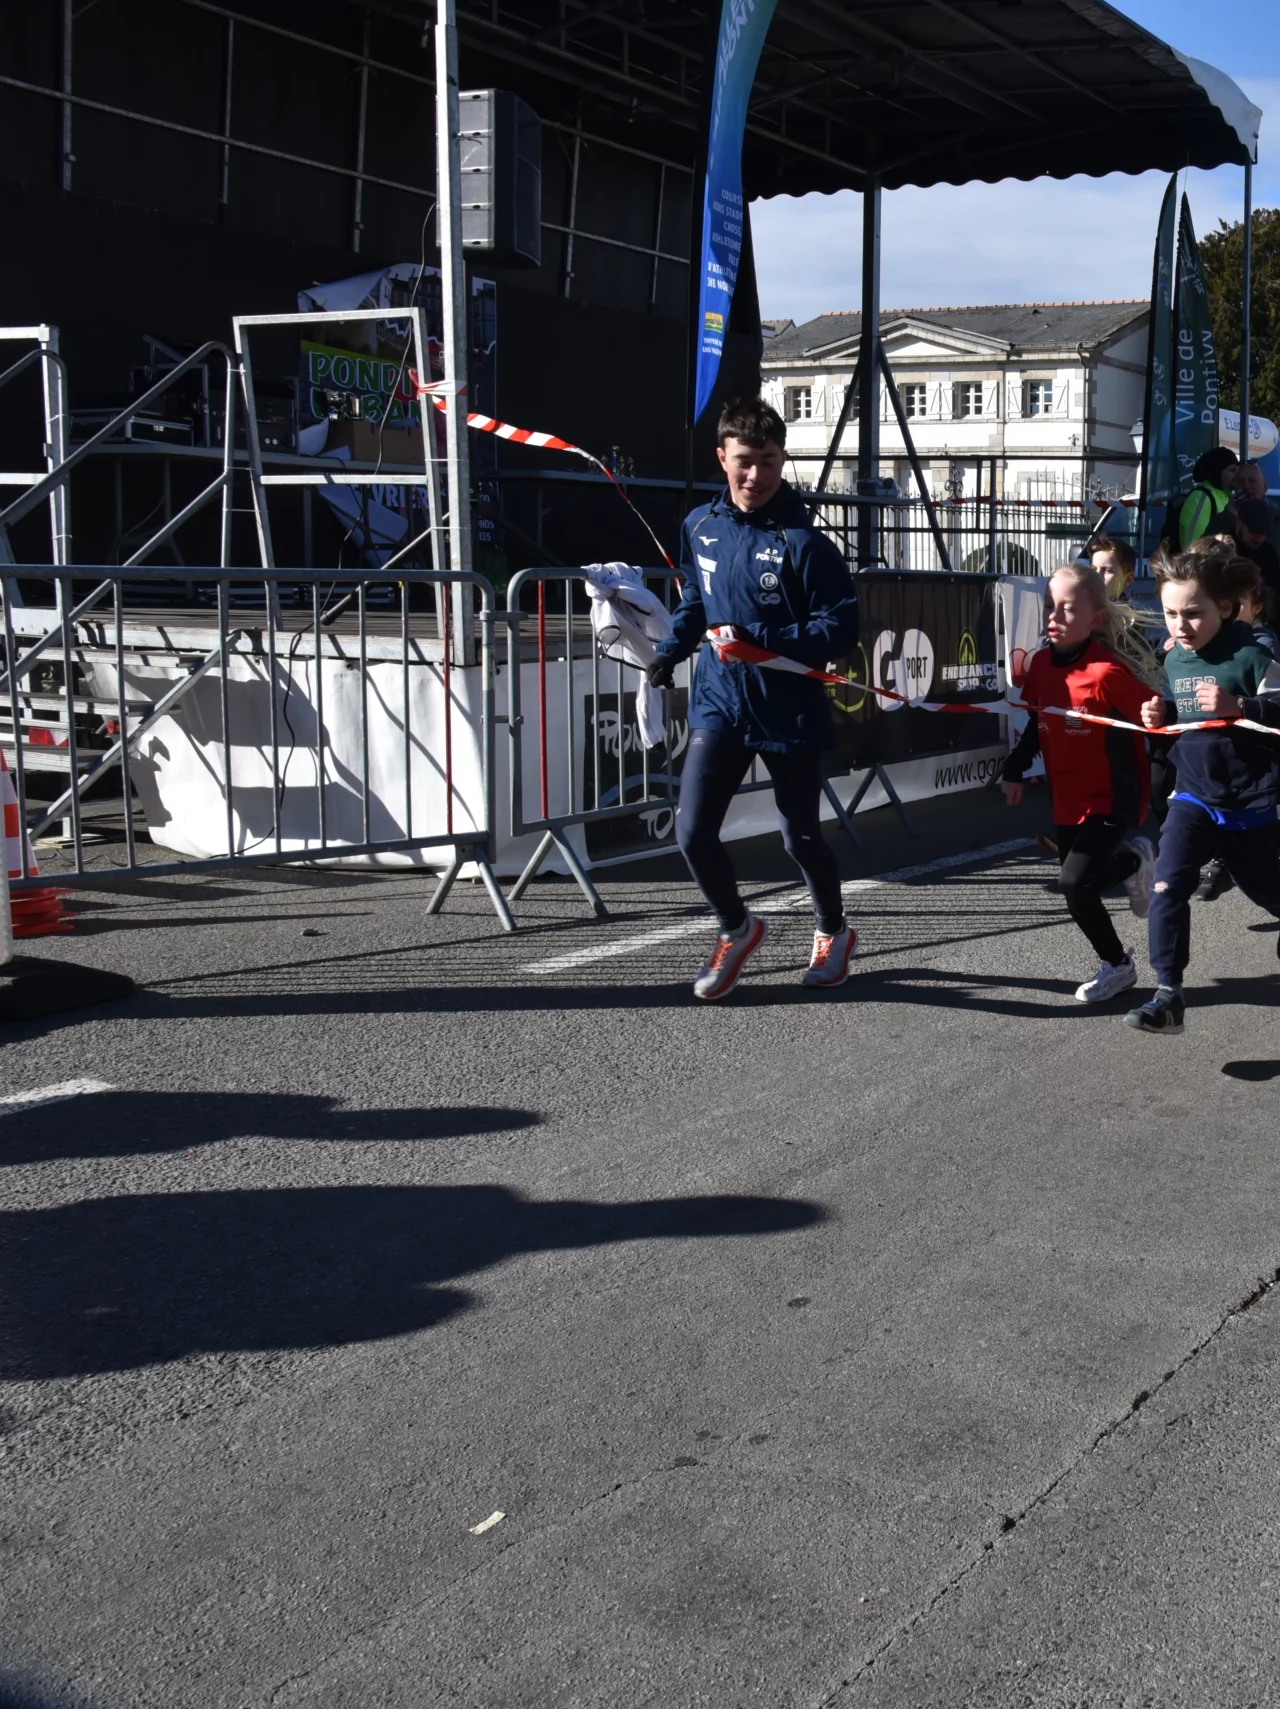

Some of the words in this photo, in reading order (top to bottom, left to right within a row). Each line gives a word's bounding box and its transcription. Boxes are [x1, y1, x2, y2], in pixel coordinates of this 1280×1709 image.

[1178, 329, 1194, 361] de
[1175, 368, 1195, 424] Ville
[639, 806, 682, 840] TO
